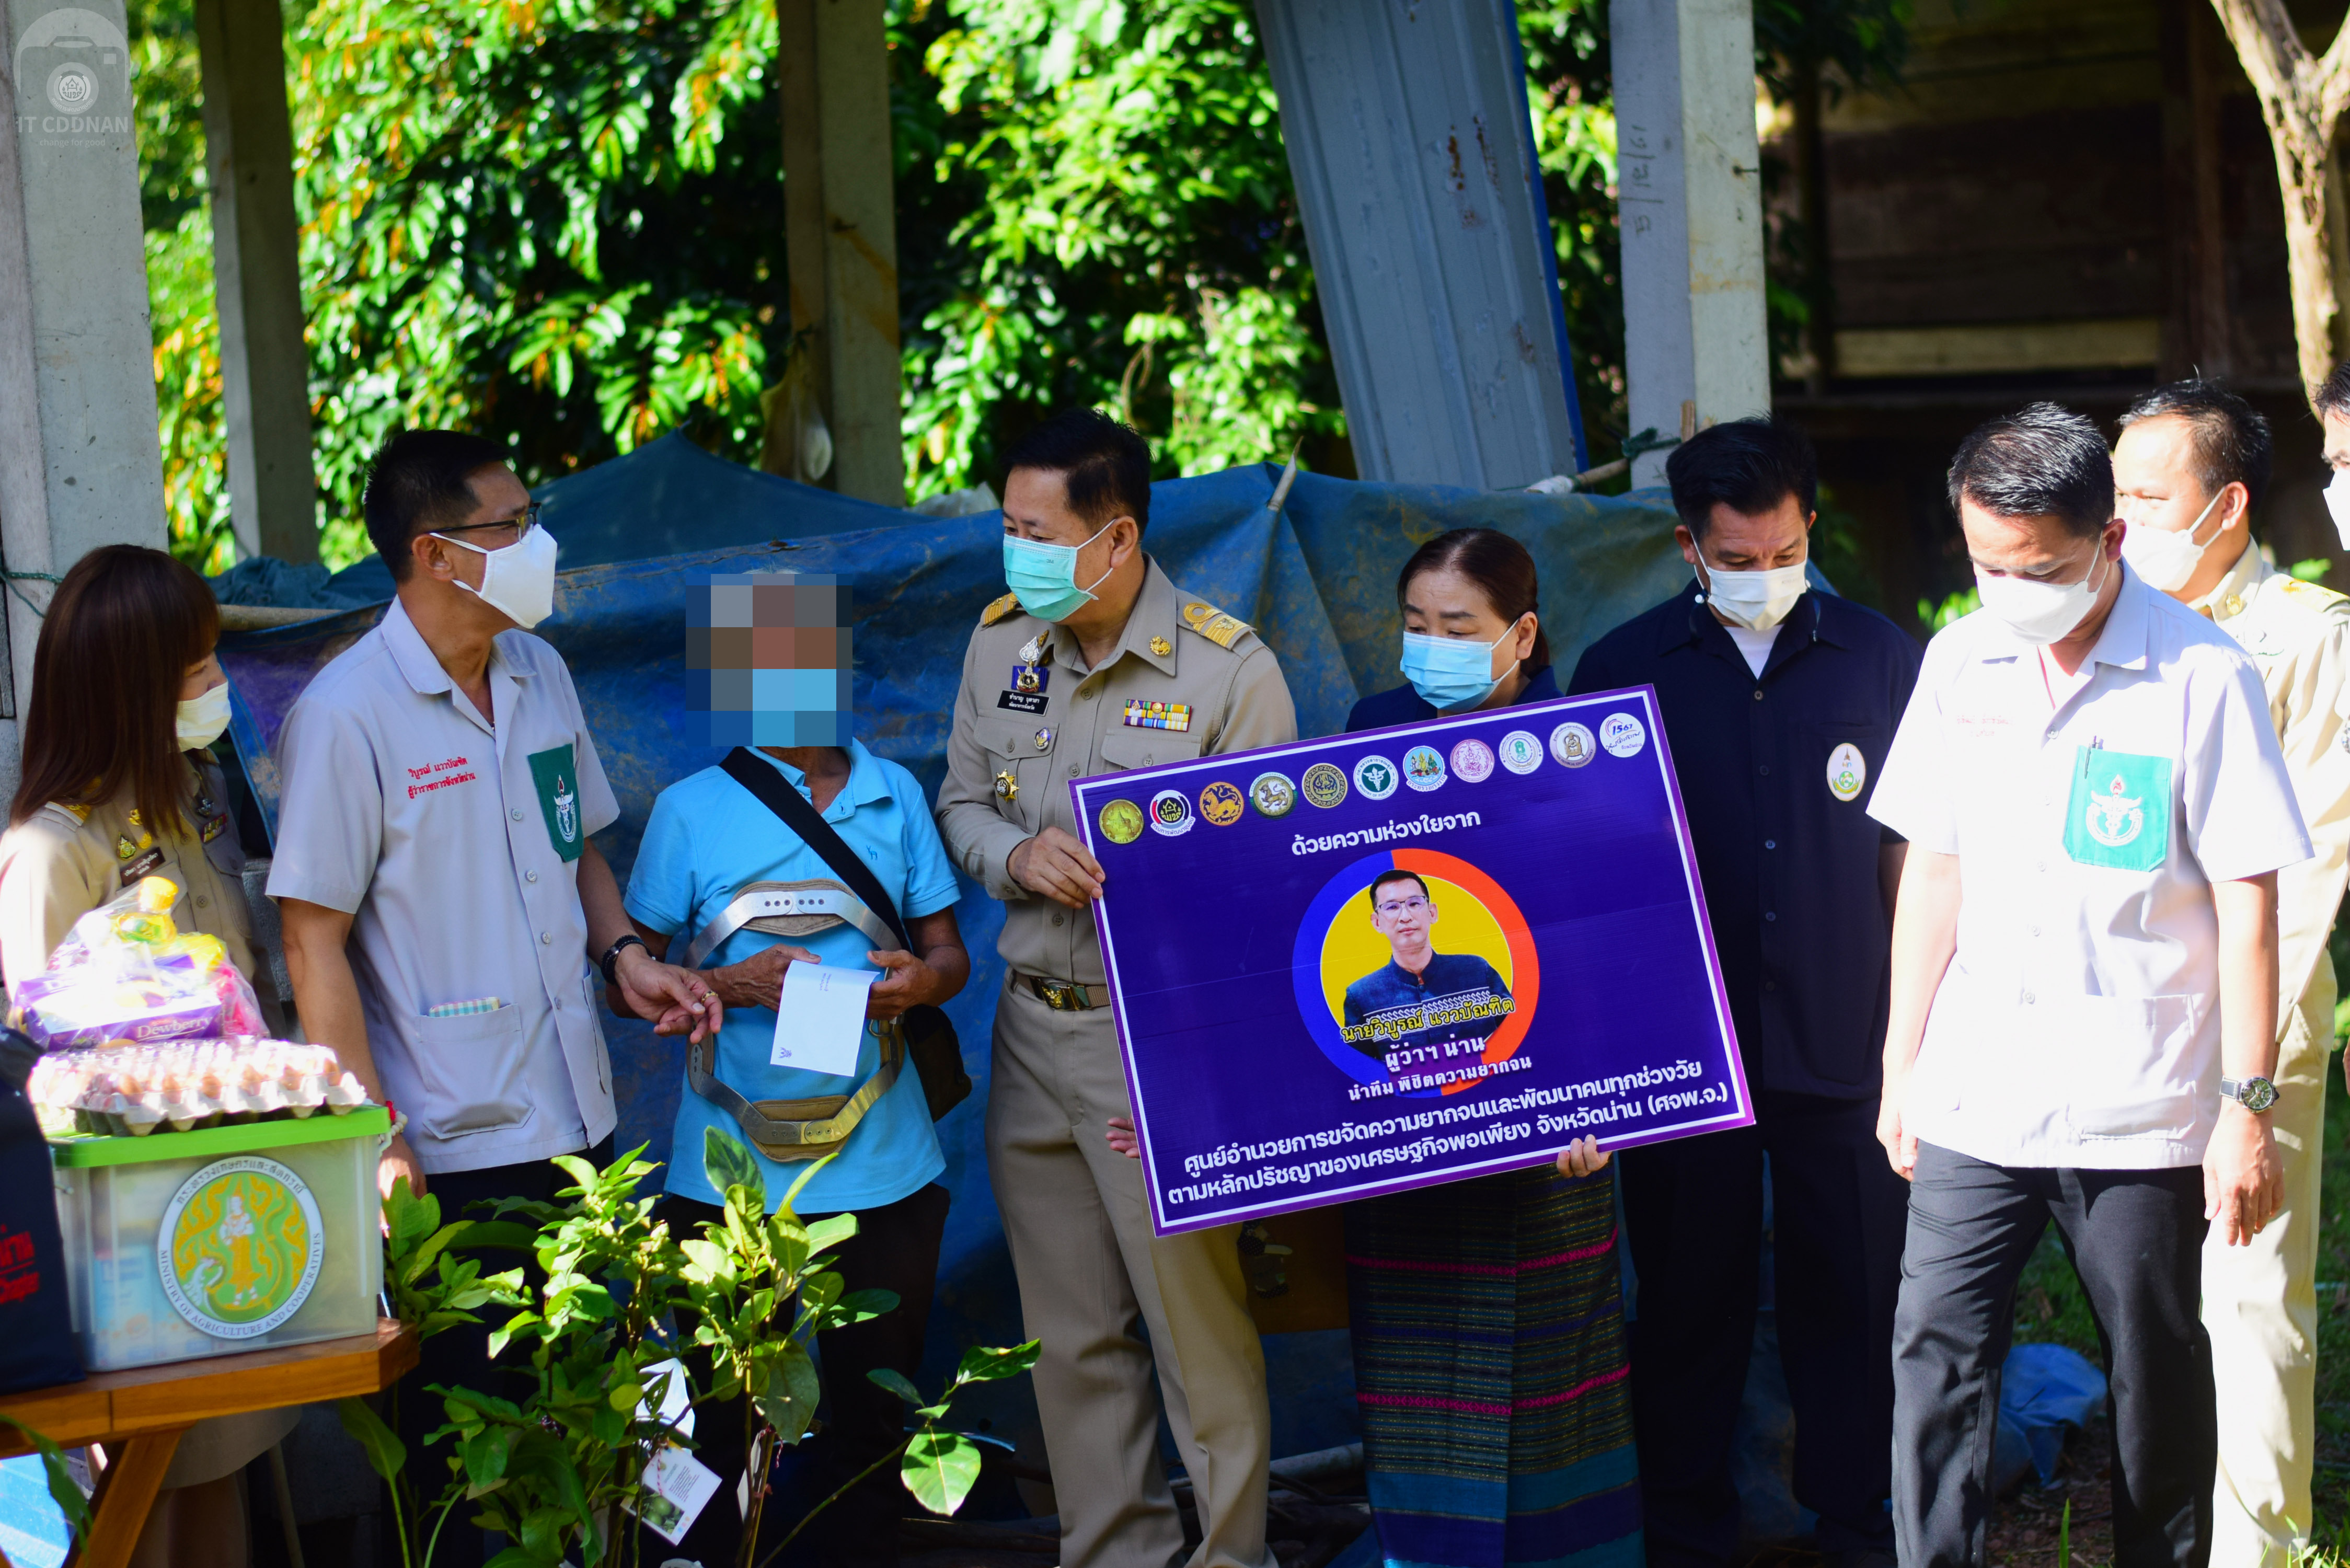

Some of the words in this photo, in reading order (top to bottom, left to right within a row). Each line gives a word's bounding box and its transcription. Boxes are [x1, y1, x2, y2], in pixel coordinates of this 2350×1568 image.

[1612, 724, 1633, 735] 1567
[1360, 784, 1372, 796] MINISTRY
[1408, 775, 1446, 790] กระทรวงแรงงาน
[1152, 817, 1194, 836] กรมการพัฒนาชุมชน
[1292, 811, 1481, 856] ด้วยความห่วงใยจาก
[136, 1016, 212, 1038] Dewberry
[1341, 1009, 1423, 1042] นายวิบูรณ์
[1429, 996, 1515, 1027] แววบัณฑิต
[1385, 1043, 1440, 1072] ผู้ว่าฯ
[1443, 1034, 1485, 1058] น่าน
[1348, 1078, 1393, 1102] นำทีม
[1398, 1056, 1532, 1091] พิชิตความยากจน
[1184, 1059, 1702, 1178] ศูนย์อำนวยการขจัดความยากจนและพัฒนาคนทุกช่วงวัย
[1168, 1122, 1530, 1204] ตามหลักปรัชญาของเศรษฐกิจพอเพียง
[1537, 1101, 1642, 1135] จังหวัดน่าน
[1648, 1082, 1728, 1115] (ศจพ.จ.)
[177, 1160, 307, 1204] กระทรวงเกษตรและสหกรณ์
[160, 1250, 181, 1304] MINISTRY
[180, 1302, 194, 1316] OF
[191, 1315, 262, 1336] AGRICULTURE
[265, 1313, 286, 1329] AND
[285, 1232, 320, 1313] COOPERATIVES
